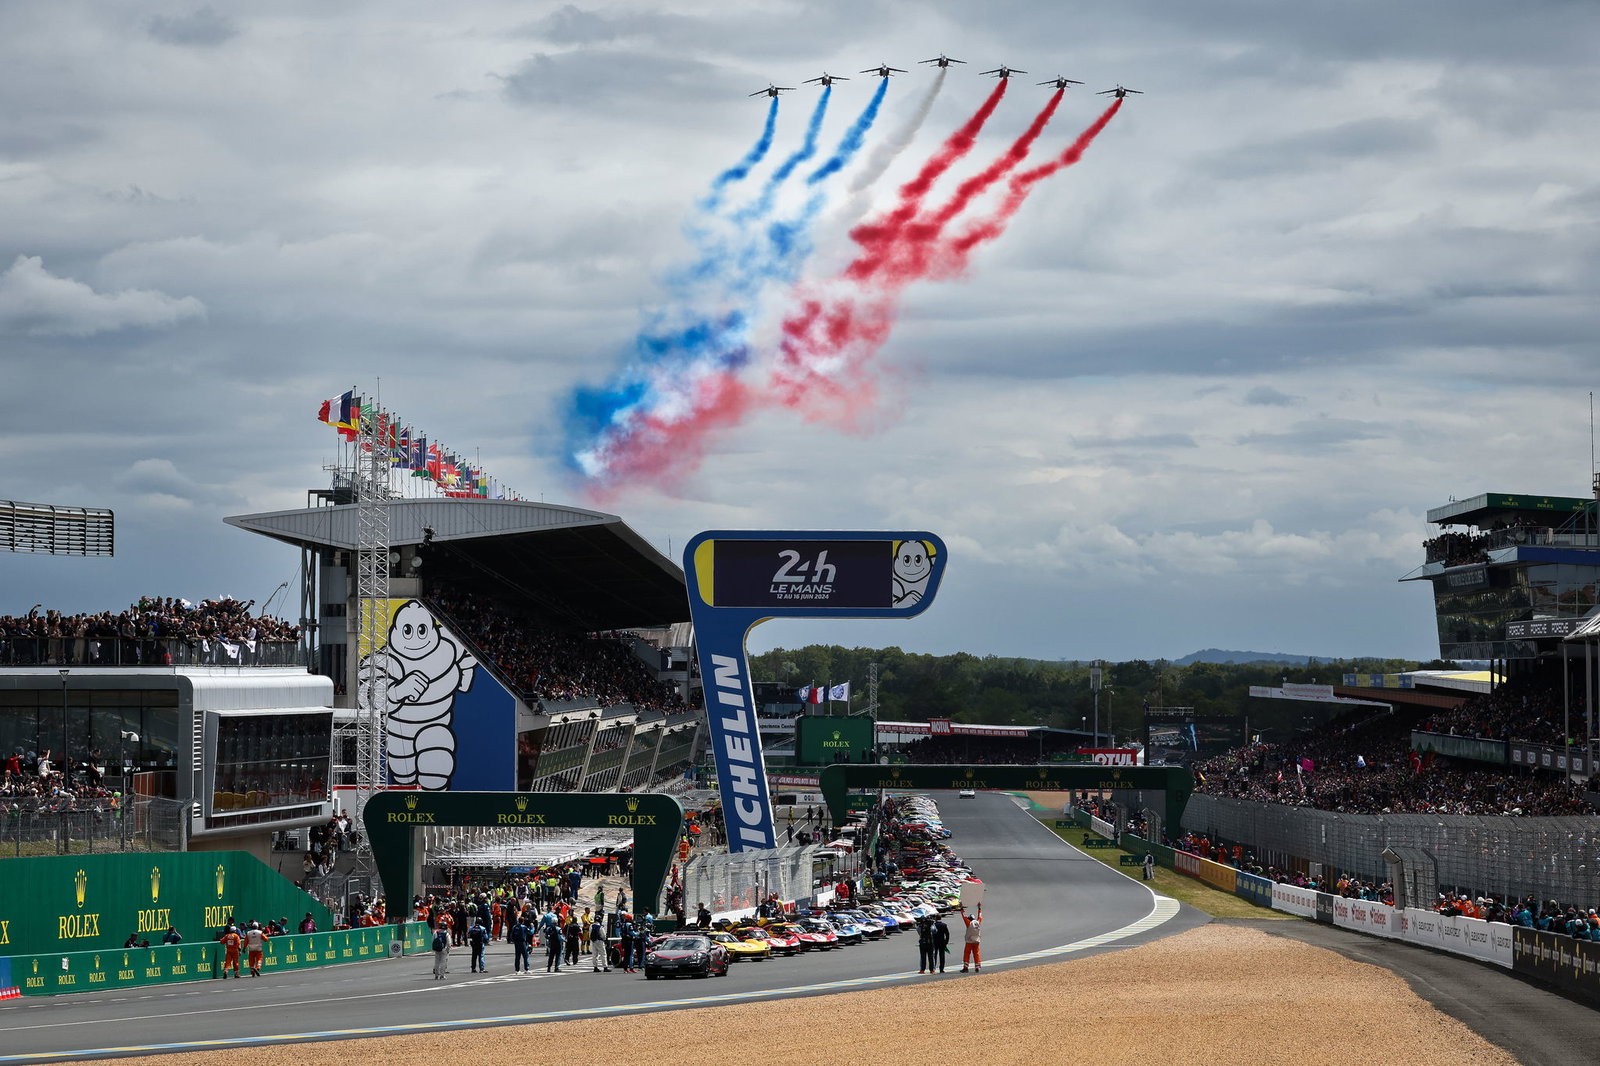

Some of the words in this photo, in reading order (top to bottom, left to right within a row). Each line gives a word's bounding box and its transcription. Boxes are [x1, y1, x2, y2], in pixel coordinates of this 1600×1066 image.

[772, 549, 837, 582] 24h
[769, 584, 788, 593] LE
[790, 584, 832, 593] MANS
[931, 720, 950, 733] MOTUL
[1091, 753, 1134, 766] OTUL
[879, 780, 913, 788] ROLEX
[952, 780, 987, 788] ROLEX
[387, 812, 436, 823] ROLEX
[497, 813, 545, 824] ROLEX
[608, 815, 657, 825] ROLEX
[138, 908, 171, 932] ROLEX
[58, 913, 100, 939] ROLEX
[146, 966, 161, 977] ROLEX
[172, 965, 187, 975] ROLEX
[197, 962, 211, 972] ROLEX
[58, 974, 75, 985] ROLEX
[89, 971, 105, 983] ROLEX
[118, 969, 134, 980] ROLEX
[26, 976, 44, 987] ROLEX
